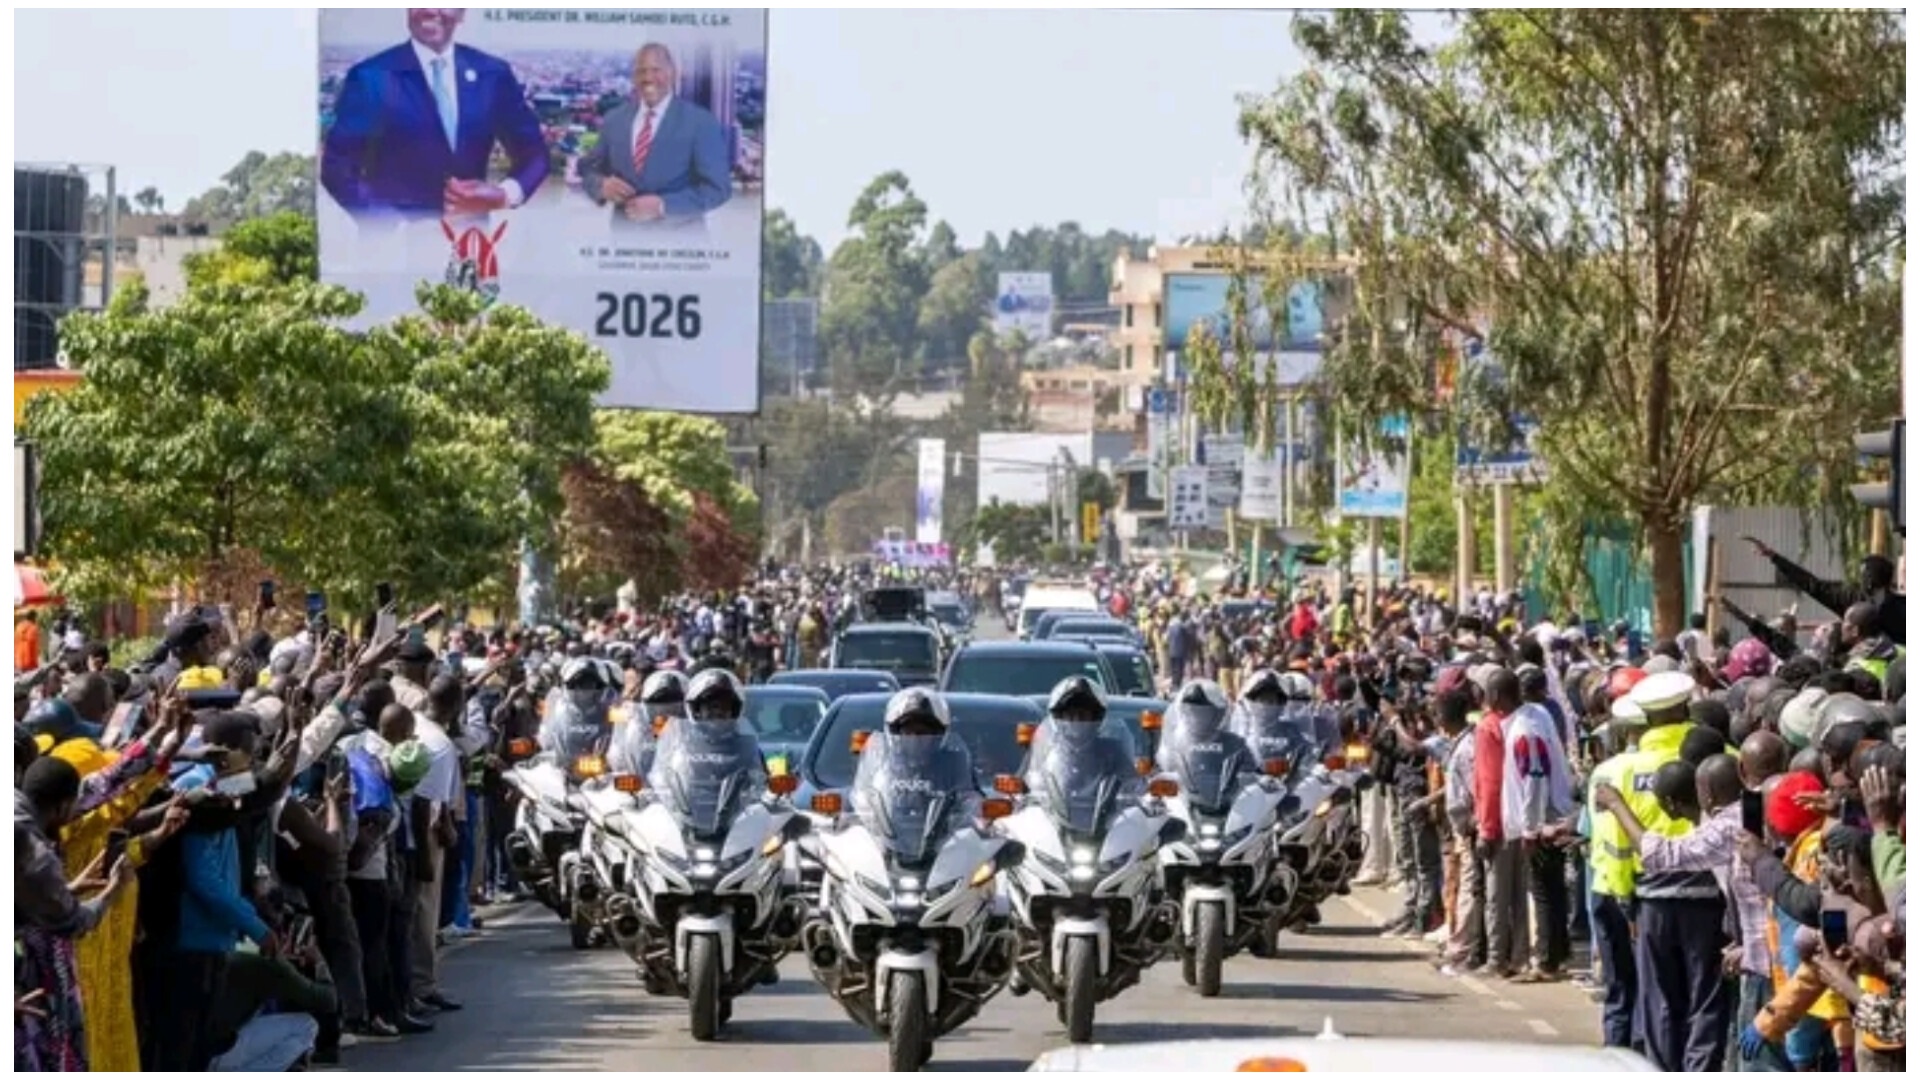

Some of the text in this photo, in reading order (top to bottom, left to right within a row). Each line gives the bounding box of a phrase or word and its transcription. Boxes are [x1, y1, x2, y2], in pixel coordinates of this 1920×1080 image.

[507, 9, 561, 23] PRESIDENT
[585, 11, 626, 24] WILLIAM
[596, 292, 701, 339] 2026
[1191, 743, 1223, 752] POLICE
[689, 752, 723, 764] POLICE
[890, 778, 931, 792] POLICE
